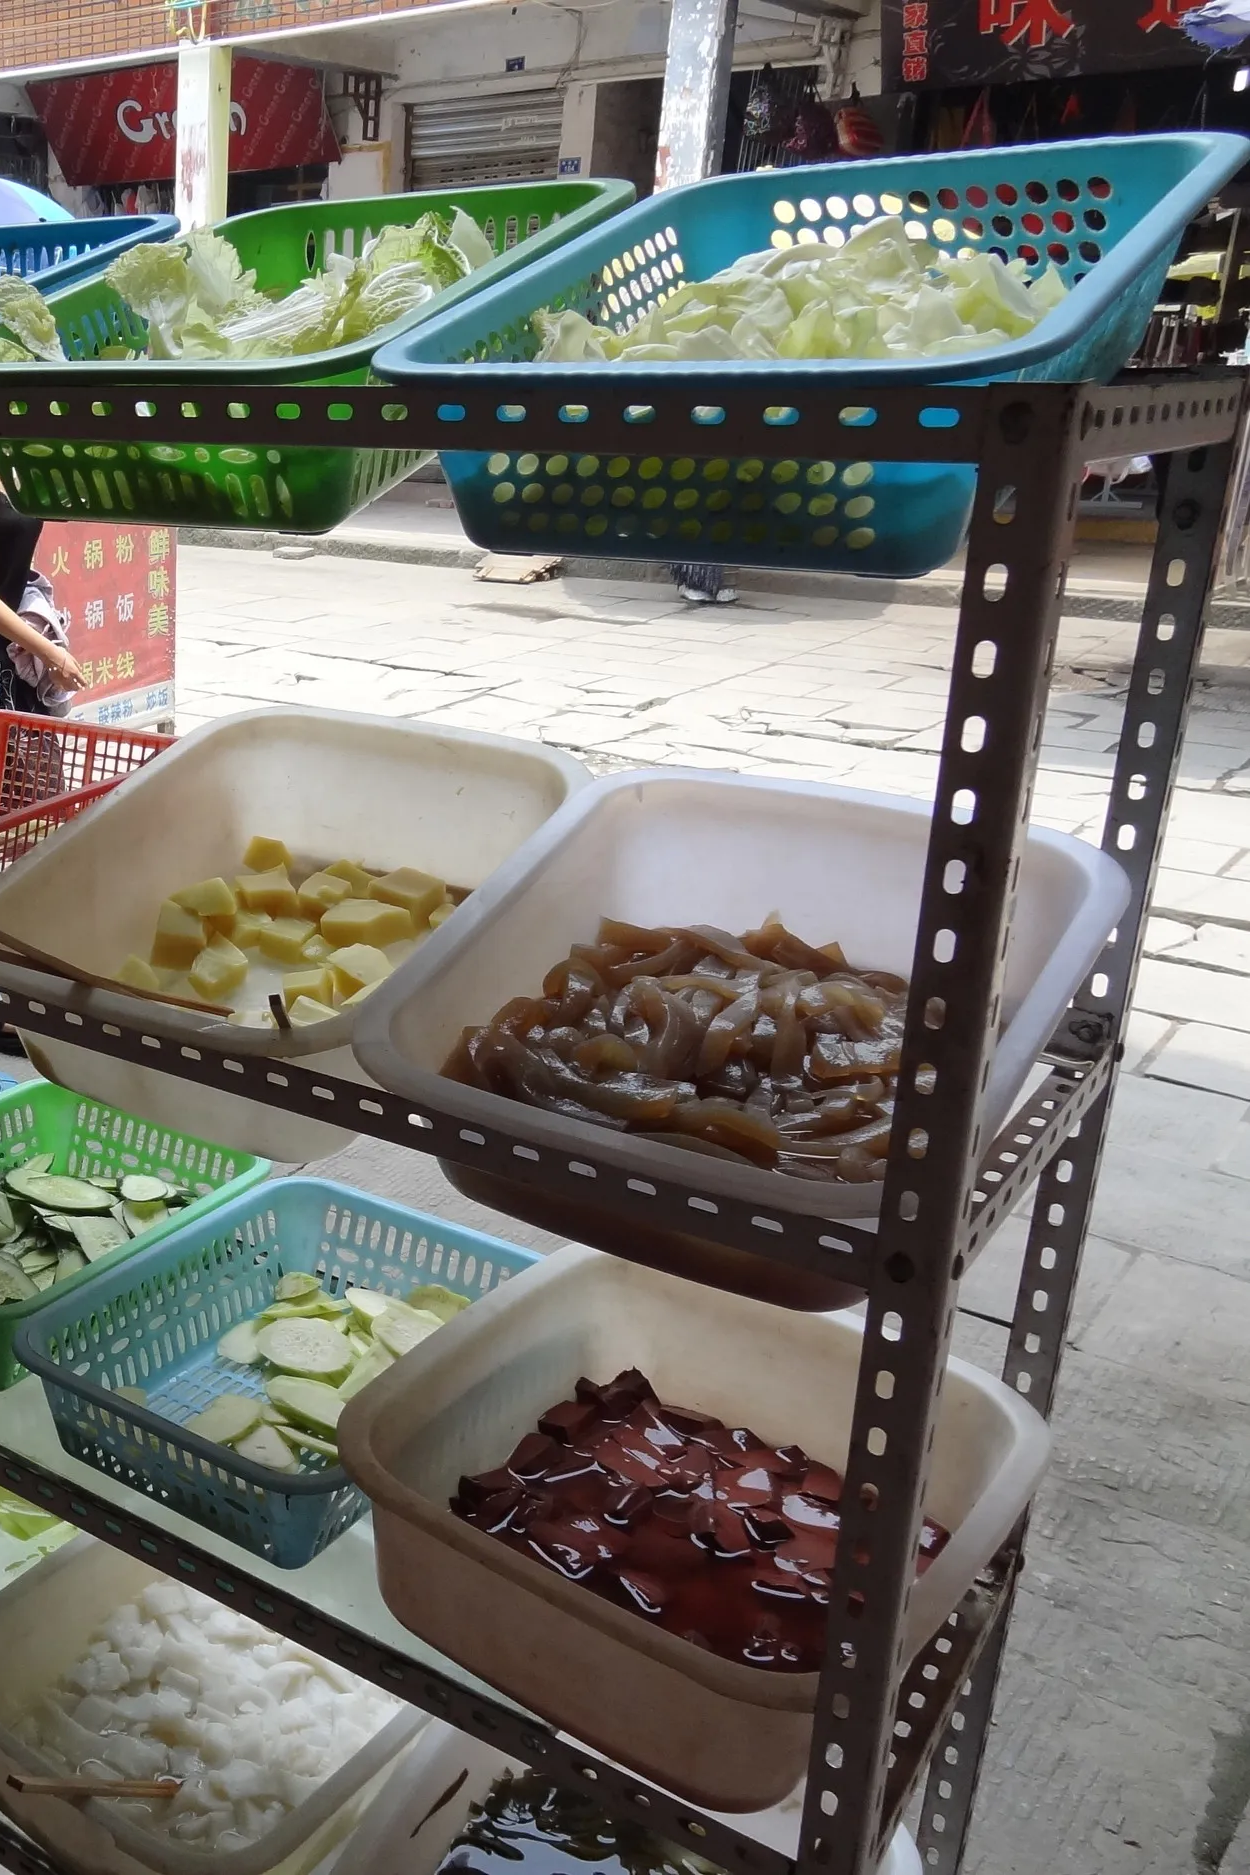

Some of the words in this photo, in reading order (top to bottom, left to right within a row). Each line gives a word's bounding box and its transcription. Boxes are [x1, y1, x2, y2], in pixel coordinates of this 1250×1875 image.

[116, 99, 247, 144] Grn
[51, 532, 135, 577] 火锅粉
[148, 528, 170, 638] 鲜味美
